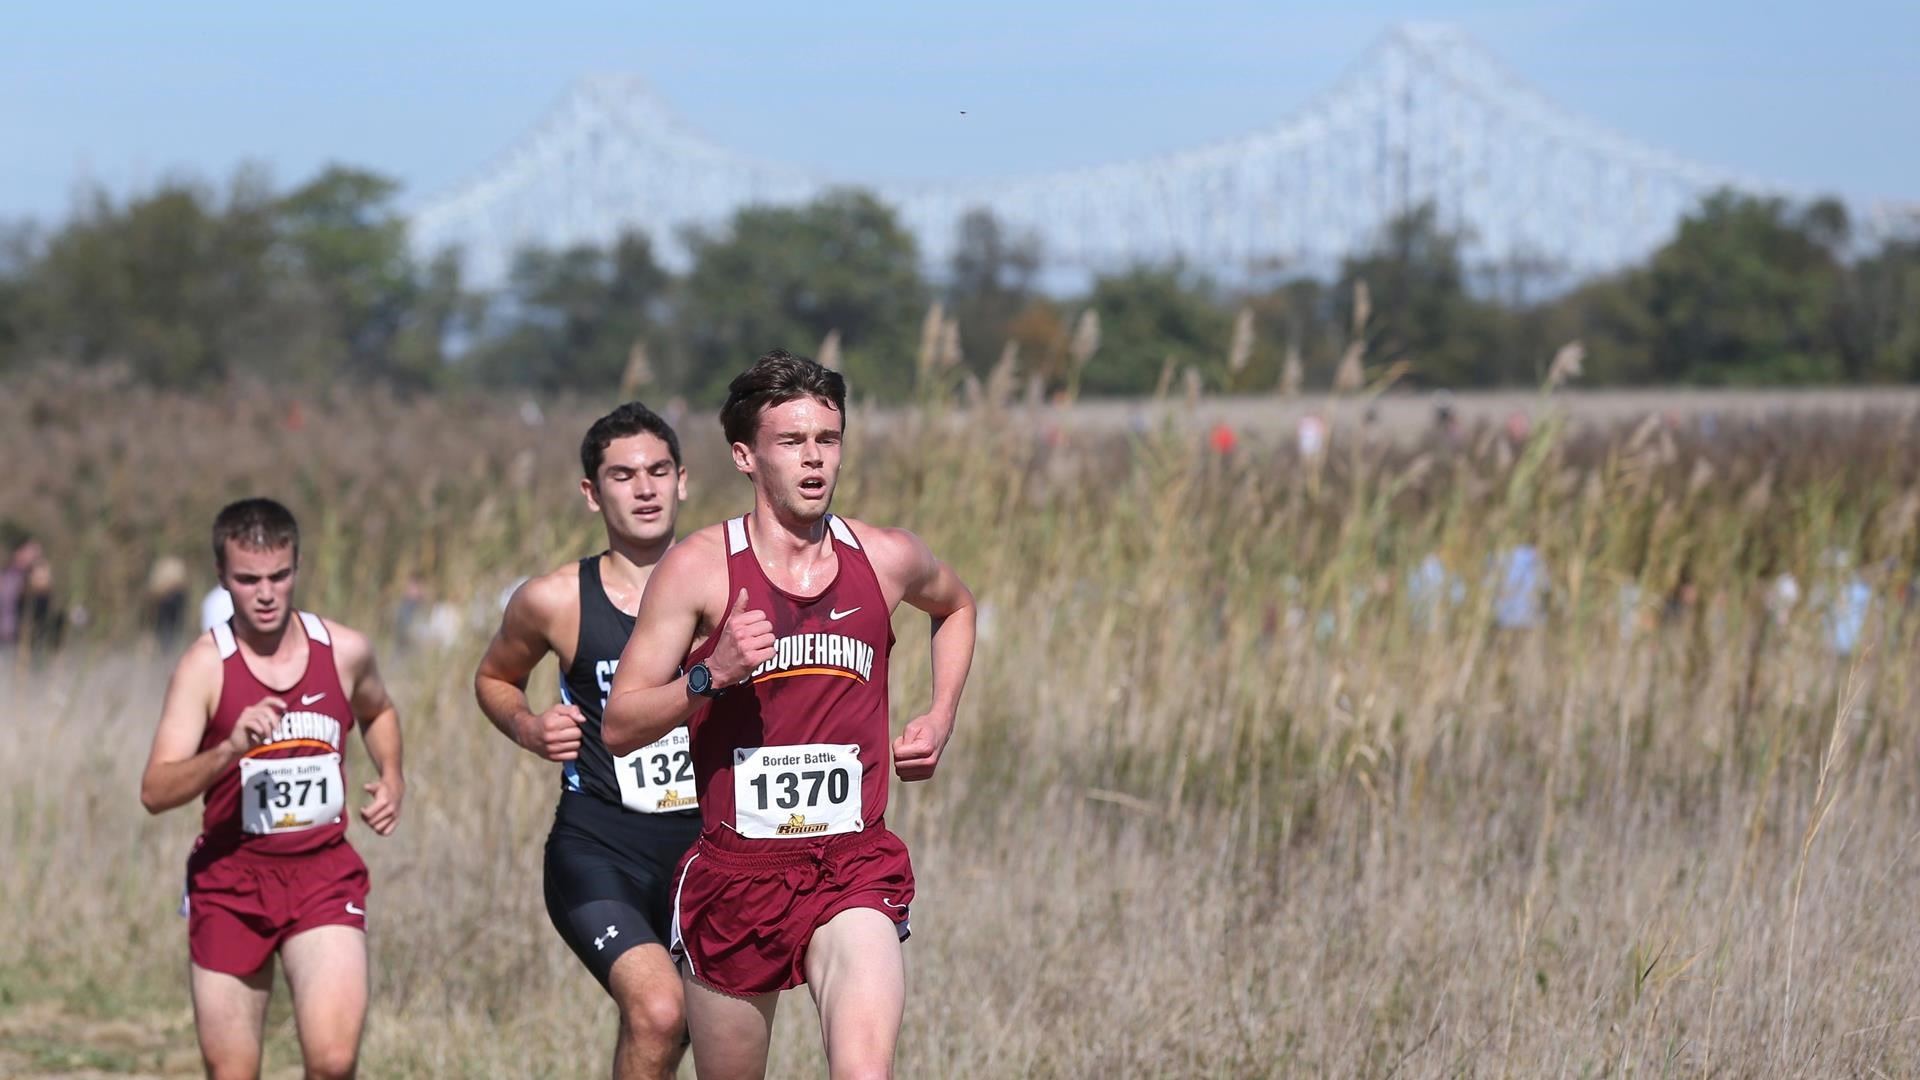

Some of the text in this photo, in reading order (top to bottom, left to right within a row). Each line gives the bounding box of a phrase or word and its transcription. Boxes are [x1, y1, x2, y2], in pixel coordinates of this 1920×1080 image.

[629, 750, 694, 789] 132
[762, 752, 837, 767] Border Battle
[254, 777, 328, 810] 1371
[750, 768, 849, 810] 1370
[776, 823, 829, 835] Rowan
